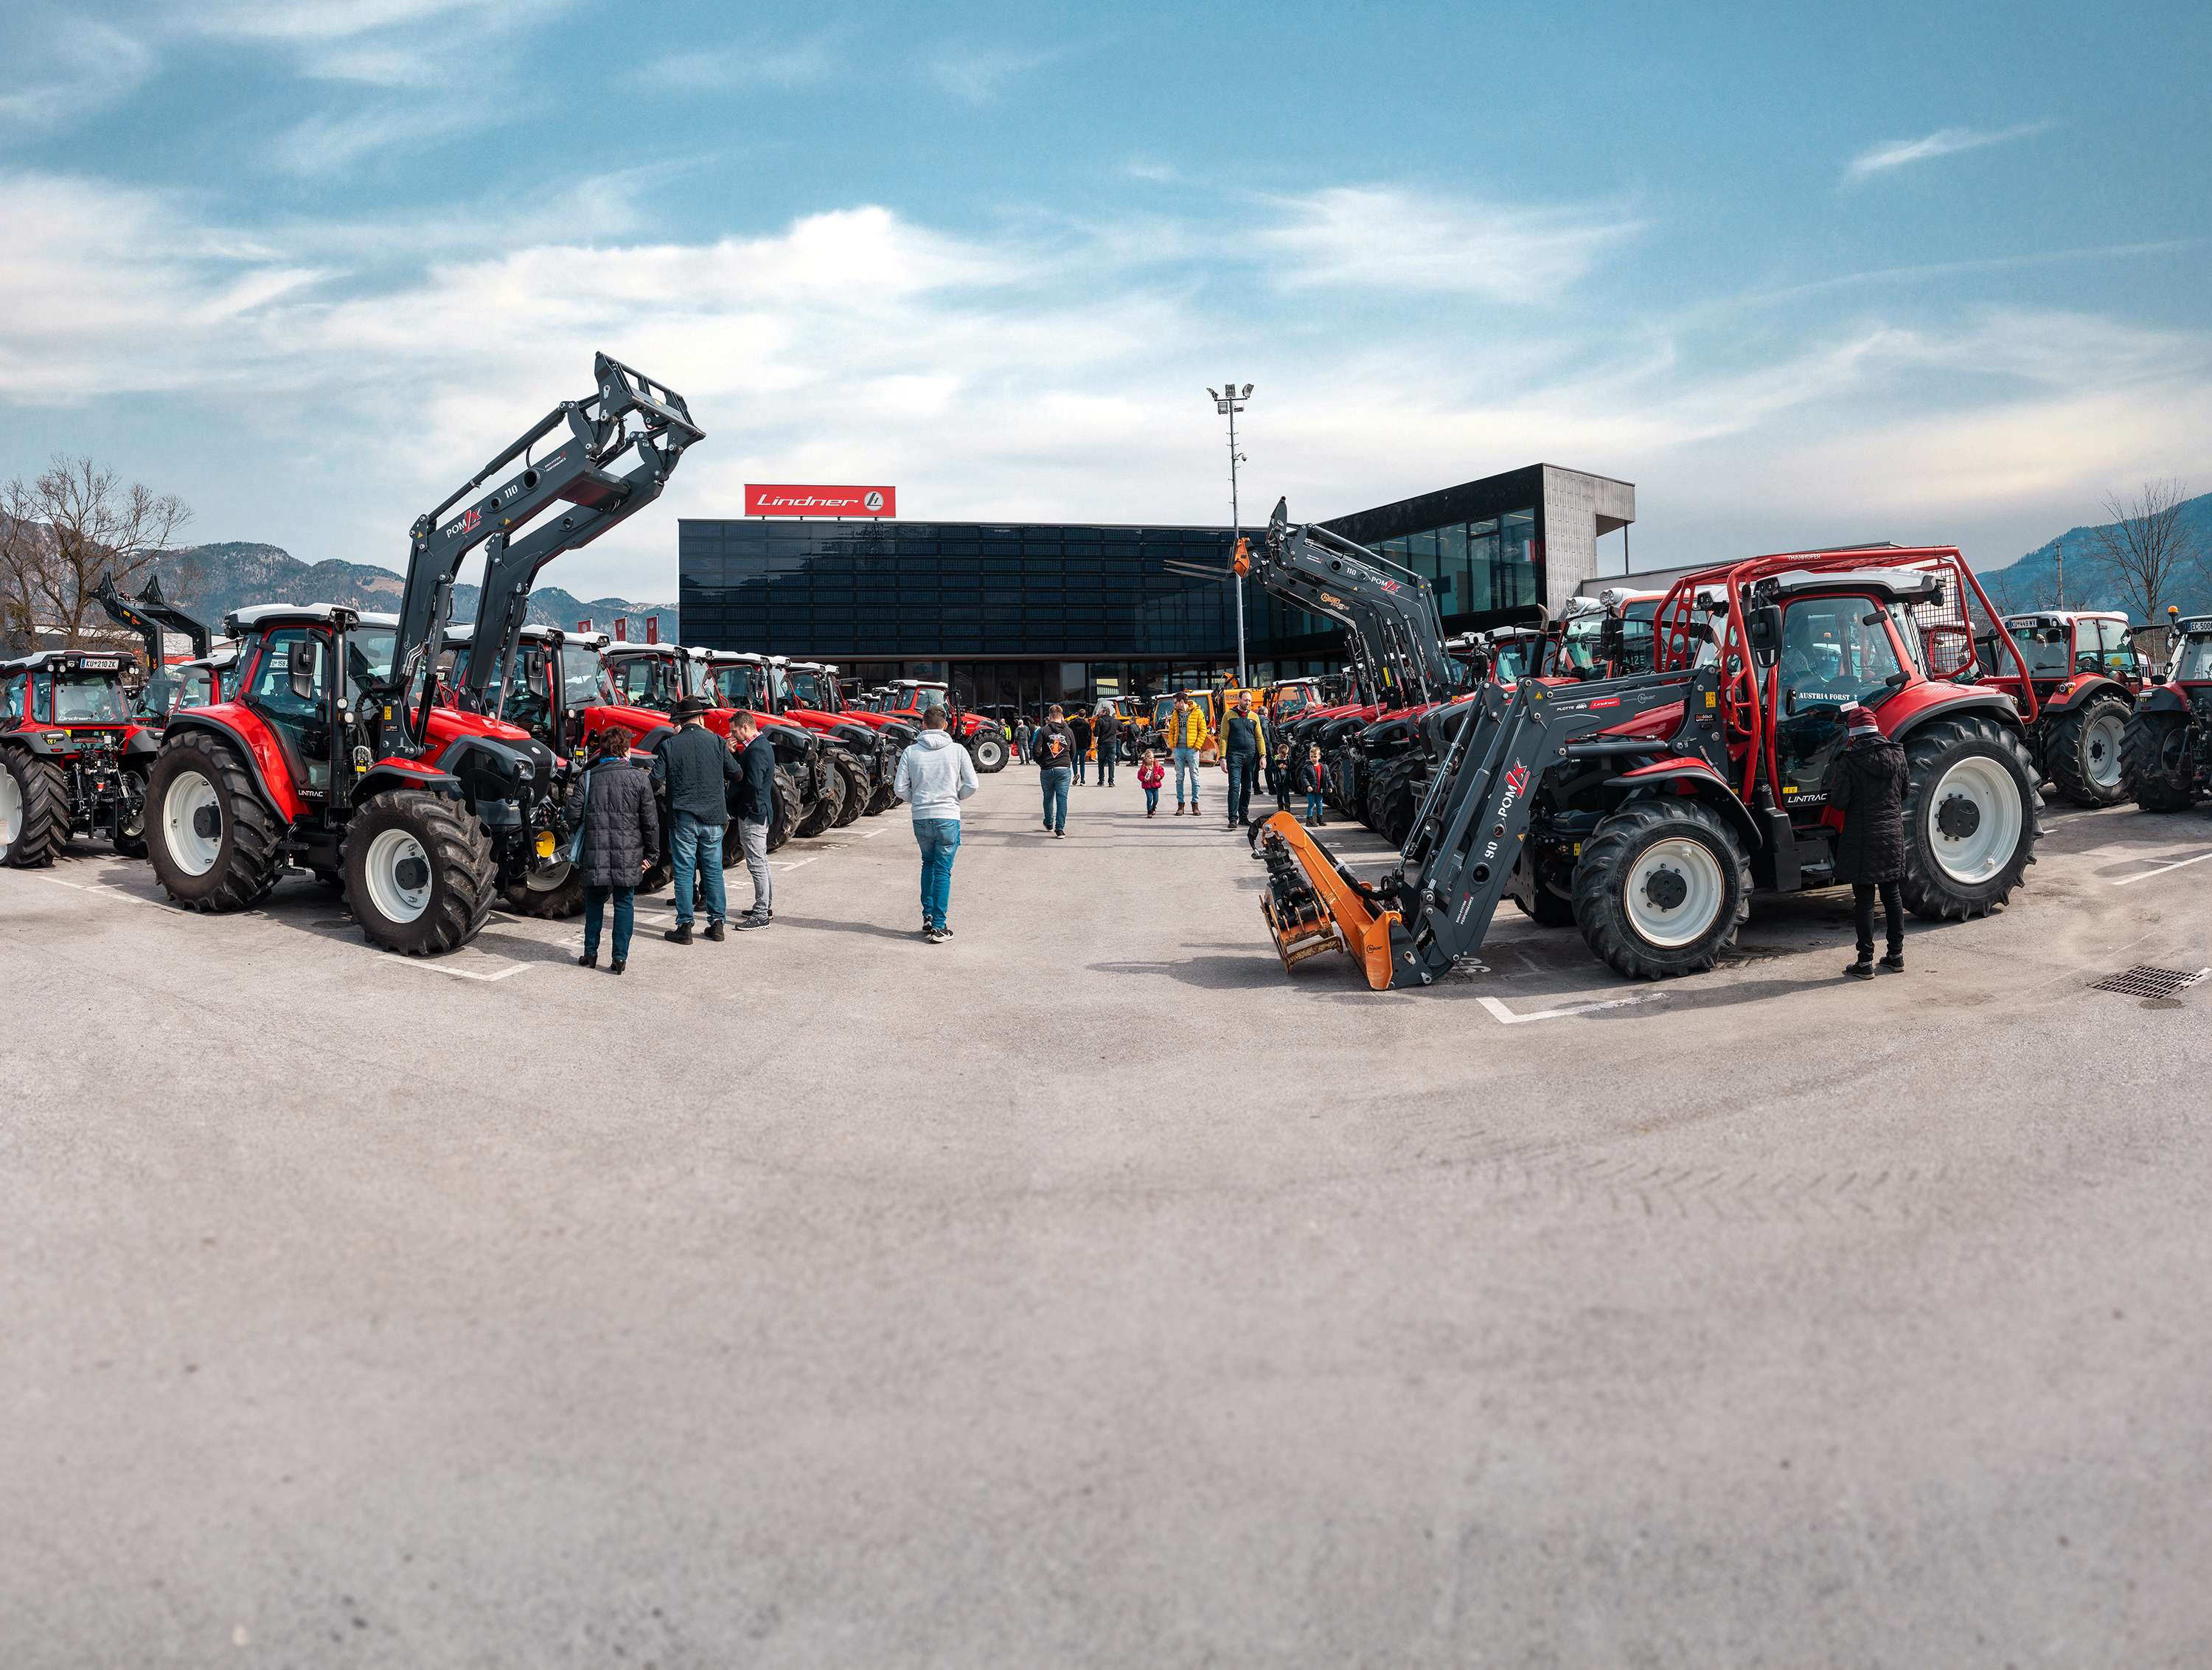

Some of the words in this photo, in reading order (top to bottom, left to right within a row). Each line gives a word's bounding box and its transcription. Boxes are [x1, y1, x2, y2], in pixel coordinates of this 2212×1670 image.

[504, 484, 518, 498] 110
[757, 493, 859, 507] Lindner
[1346, 567, 1357, 576] 110
[1787, 793, 1828, 804] LINTRAC
[1484, 841, 1498, 859] 90
